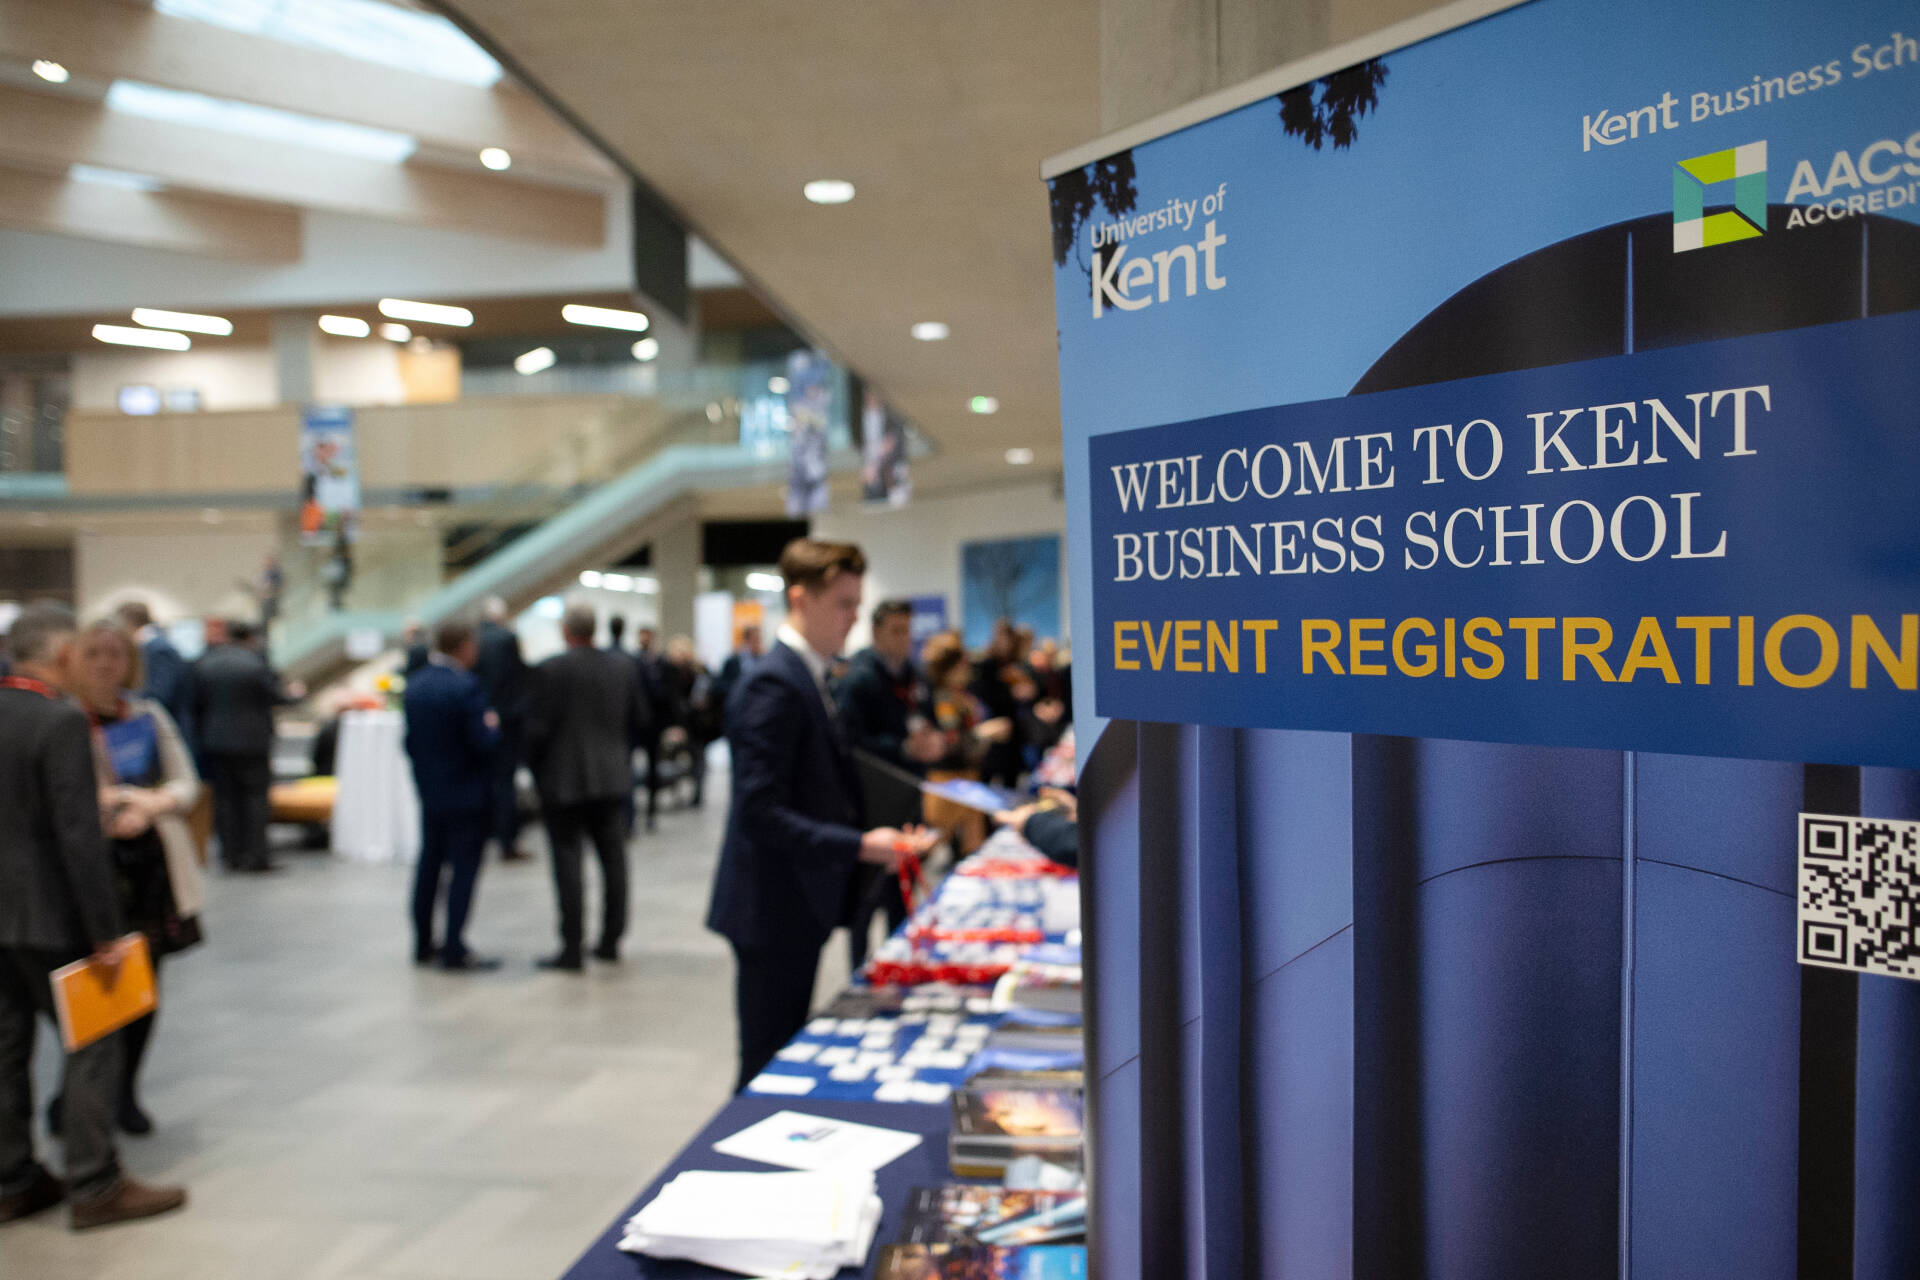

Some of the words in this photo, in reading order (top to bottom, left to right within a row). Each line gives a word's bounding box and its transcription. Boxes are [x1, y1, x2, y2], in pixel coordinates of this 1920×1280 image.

[1582, 91, 1679, 152] Kent
[1690, 60, 1841, 123] Business
[1852, 32, 1920, 78] Sch
[1091, 197, 1197, 248] University
[1202, 182, 1227, 216] of
[1786, 180, 1920, 230] ACCREDI
[1091, 219, 1227, 319] Kent
[1111, 431, 1395, 514] WELCOME
[1412, 418, 1503, 485] TO
[1526, 385, 1771, 475] KENT
[1113, 514, 1385, 582] BUSINESS
[1404, 492, 1727, 570] SCHOOL
[1113, 619, 1279, 674] EVENT
[1300, 613, 1919, 690] REGISTRATION
